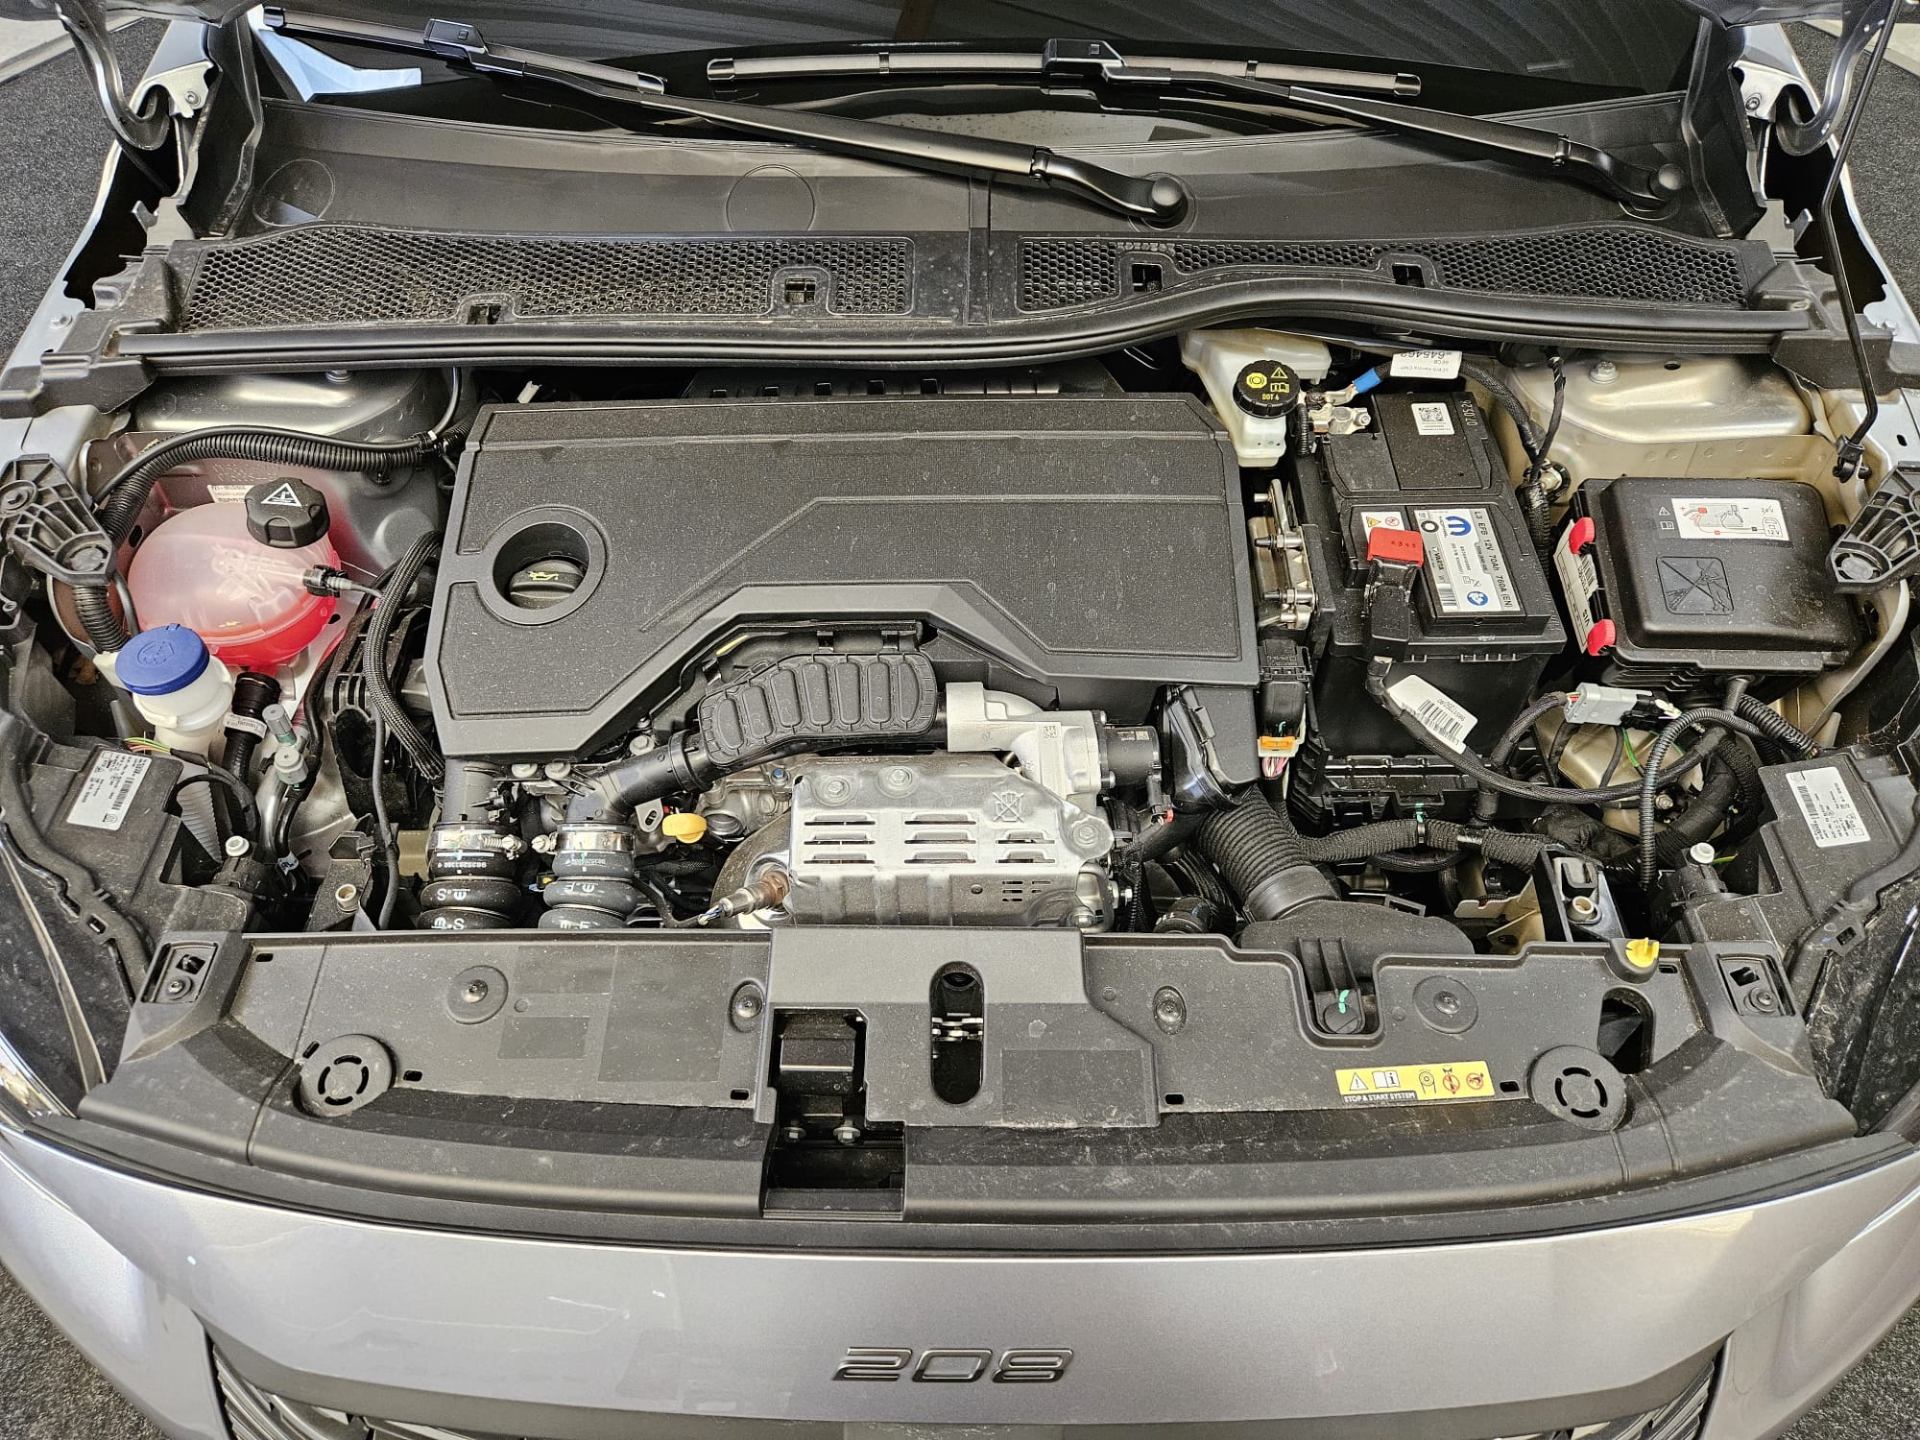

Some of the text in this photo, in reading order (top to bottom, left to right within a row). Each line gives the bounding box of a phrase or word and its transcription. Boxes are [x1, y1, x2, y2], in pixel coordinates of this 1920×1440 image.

[1484, 539, 1494, 552] 12V
[1489, 554, 1500, 571] 70Ah
[1368, 1093, 1389, 1101] START
[1389, 1091, 1416, 1100] SYSTEM
[832, 1347, 1074, 1383] 208
